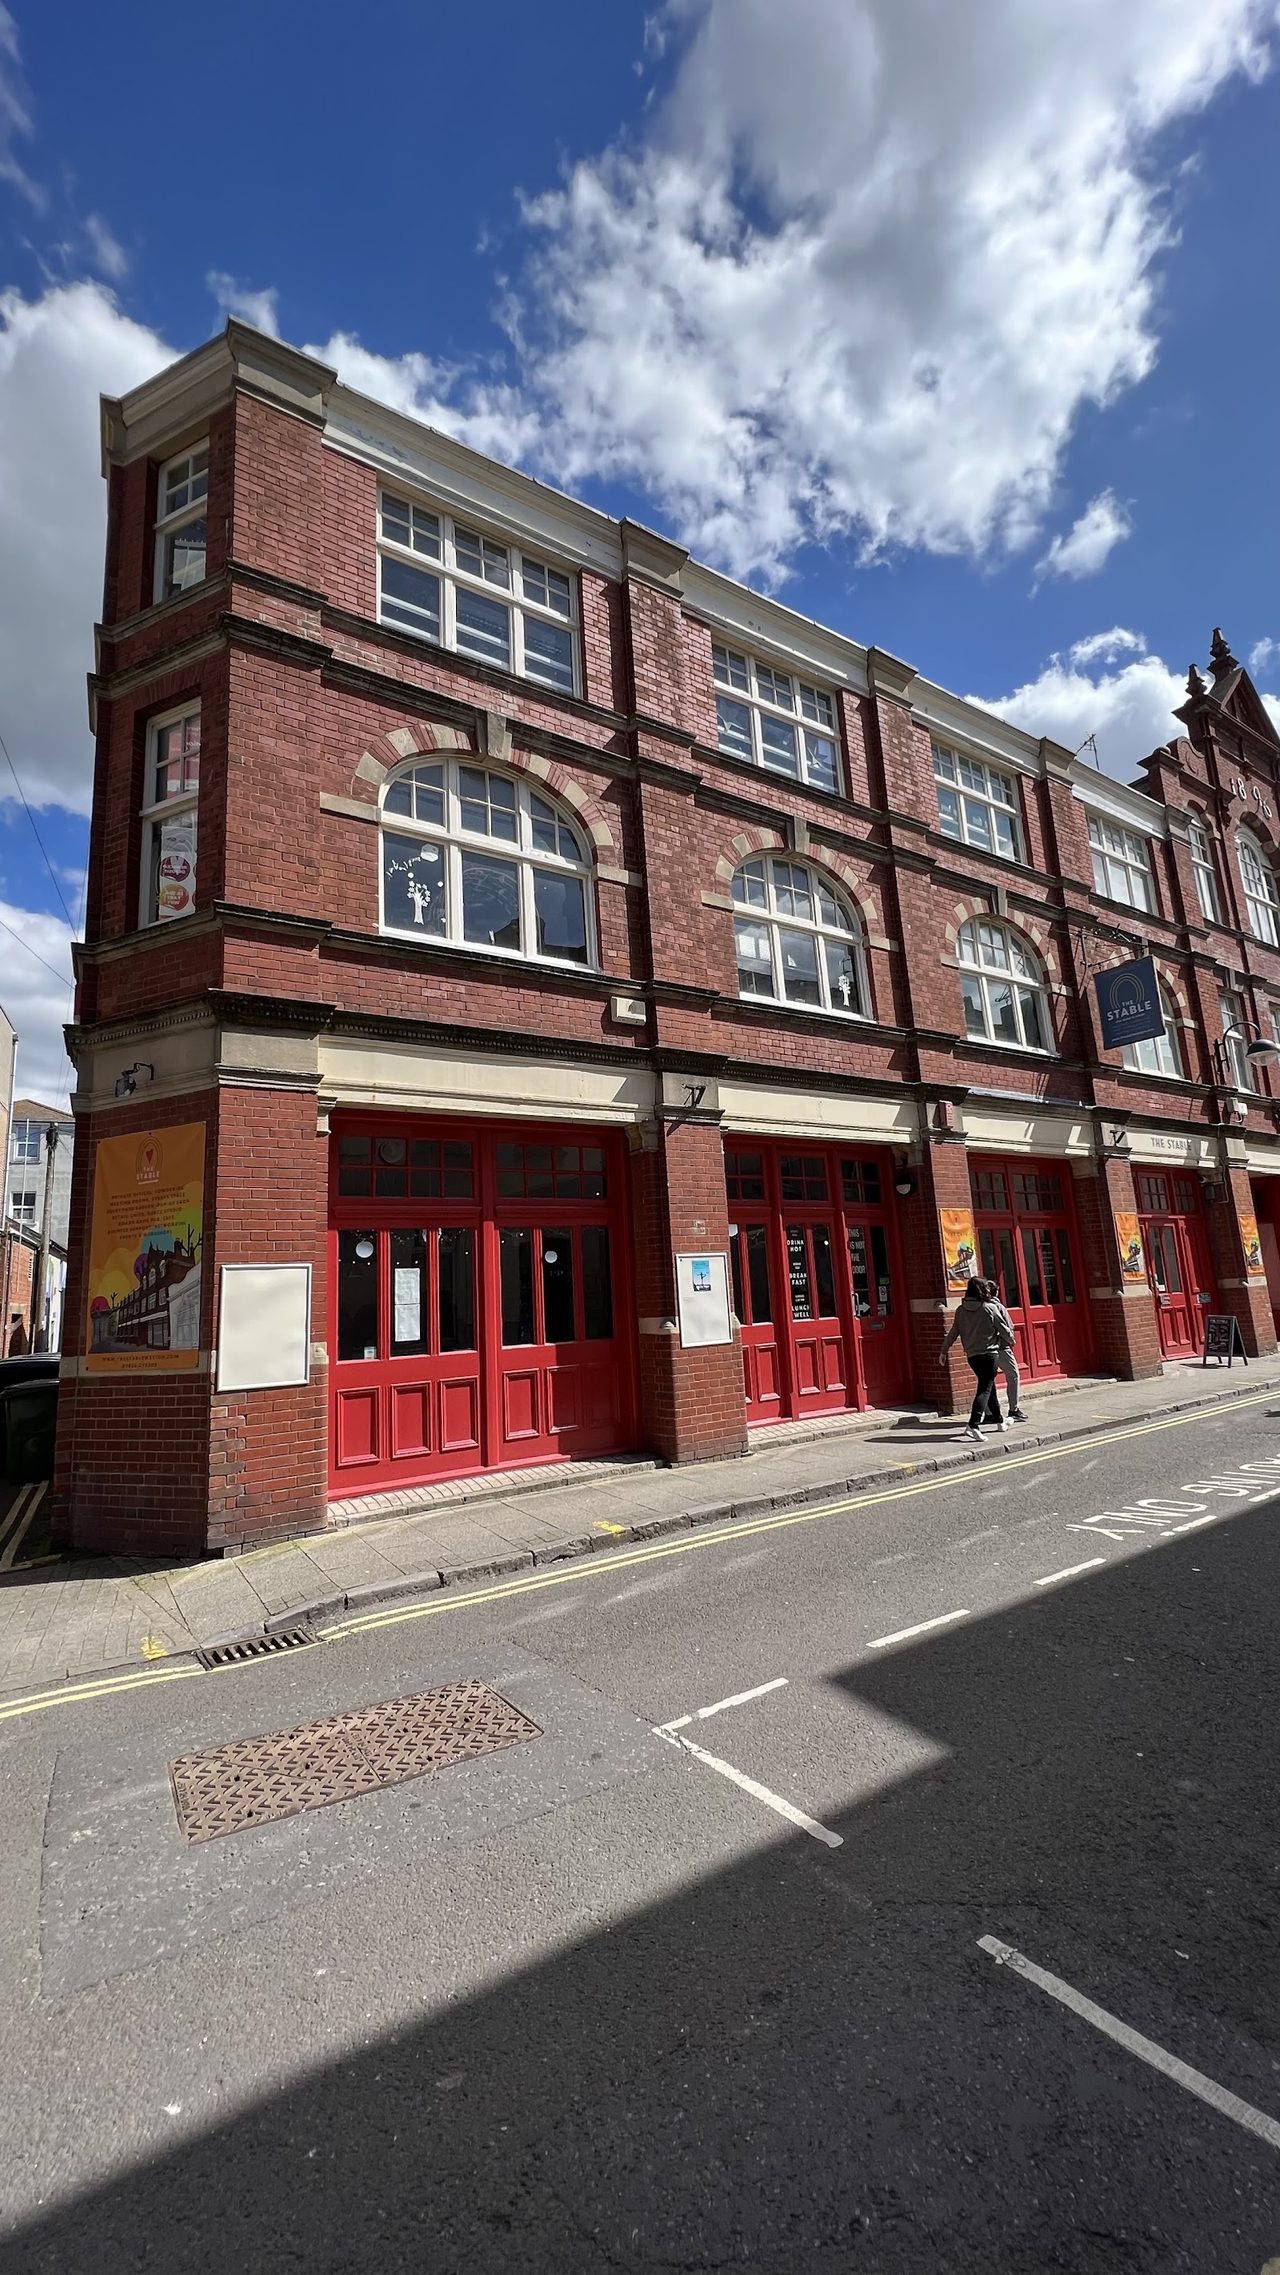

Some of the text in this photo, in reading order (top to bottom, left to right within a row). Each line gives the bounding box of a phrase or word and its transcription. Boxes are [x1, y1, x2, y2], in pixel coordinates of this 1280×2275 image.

[1121, 999, 1134, 1007] THE
[1106, 1000, 1152, 1022] STABLE
[1151, 1137, 1193, 1151] THE STABLE
[136, 1171, 160, 1180] STABLE
[1064, 1498, 1208, 1541] ONLY
